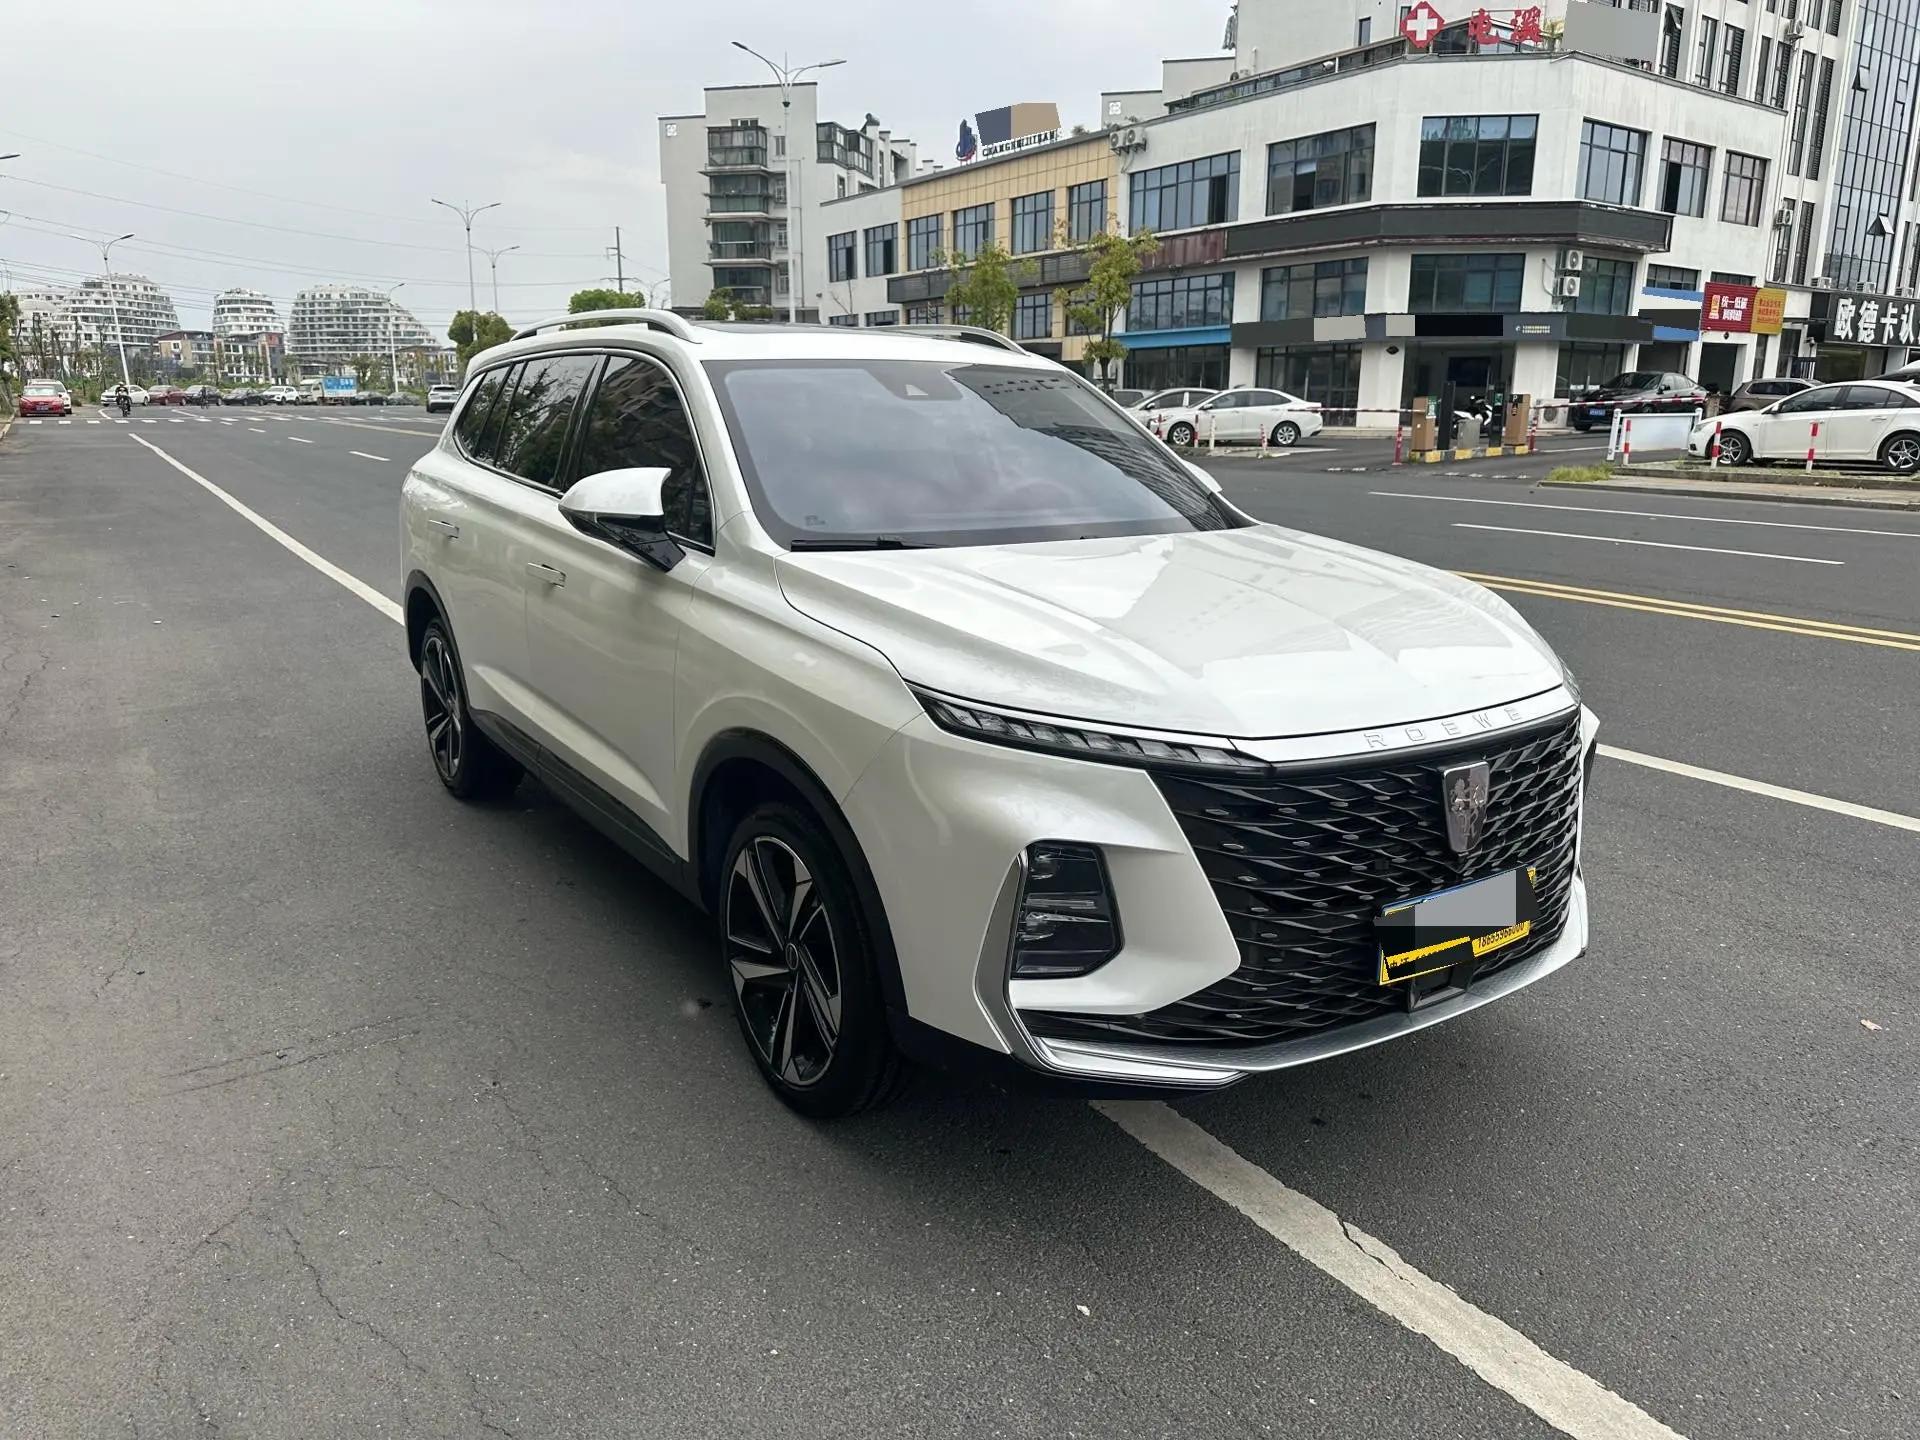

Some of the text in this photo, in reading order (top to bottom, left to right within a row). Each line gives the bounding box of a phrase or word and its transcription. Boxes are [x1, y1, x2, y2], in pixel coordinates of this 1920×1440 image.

[1834, 297, 1920, 346] 欧德卡认
[1363, 707, 1523, 749] ROEWE
